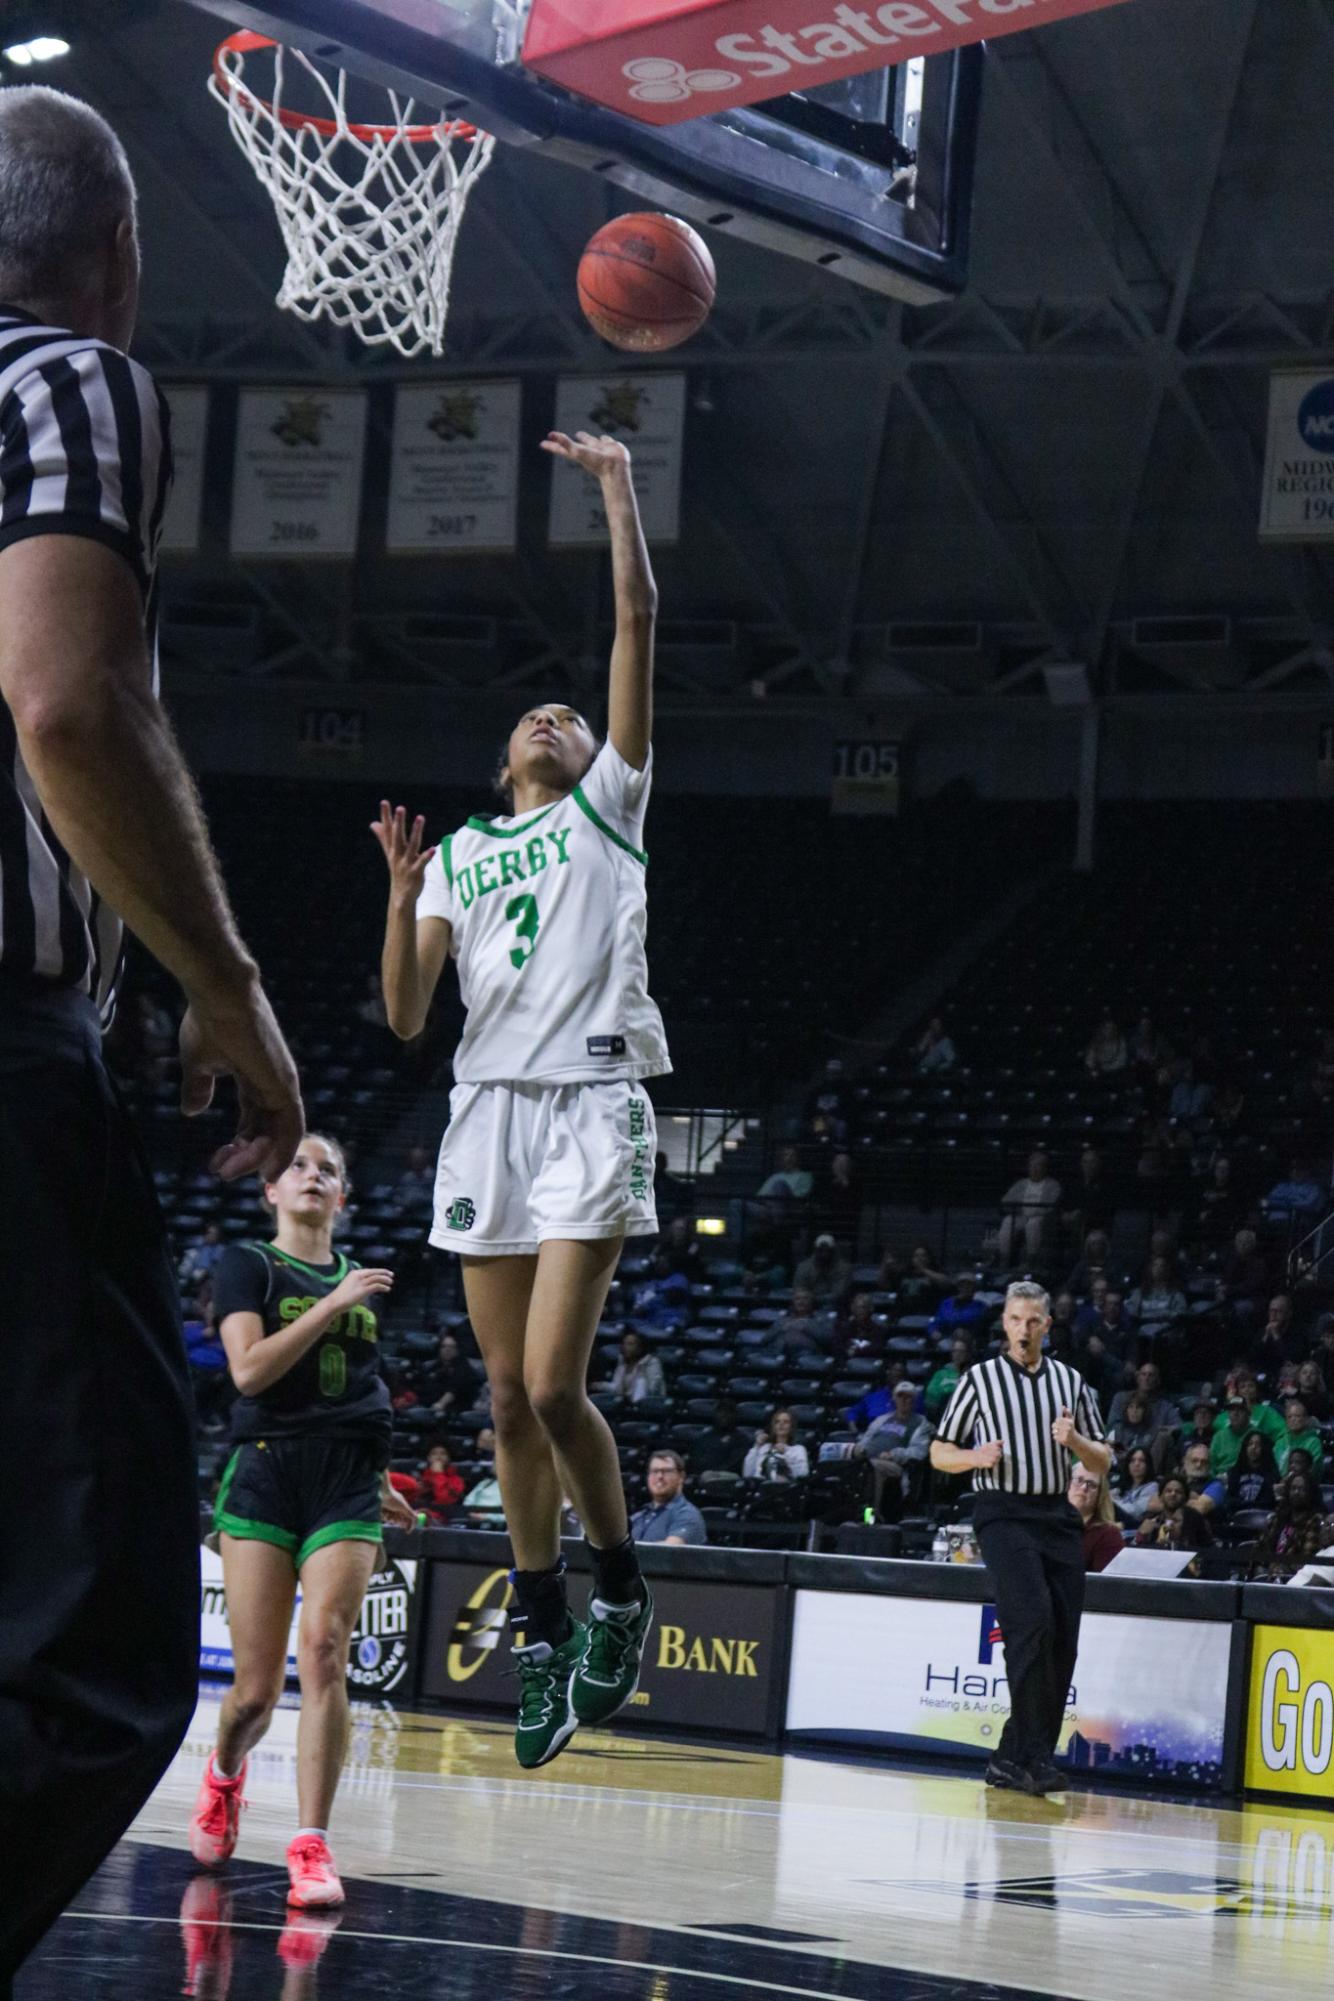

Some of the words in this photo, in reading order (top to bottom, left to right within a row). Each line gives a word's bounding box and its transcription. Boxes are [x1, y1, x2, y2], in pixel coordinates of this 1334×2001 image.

[426, 514, 476, 536] 2017
[834, 744, 898, 778] 105
[456, 828, 571, 910] DERBY
[505, 892, 540, 970] 3
[627, 1097, 649, 1202] PANTHERS
[656, 1625, 760, 1677] BANK
[919, 1696, 960, 1712] Heating
[974, 1701, 988, 1712] Air
